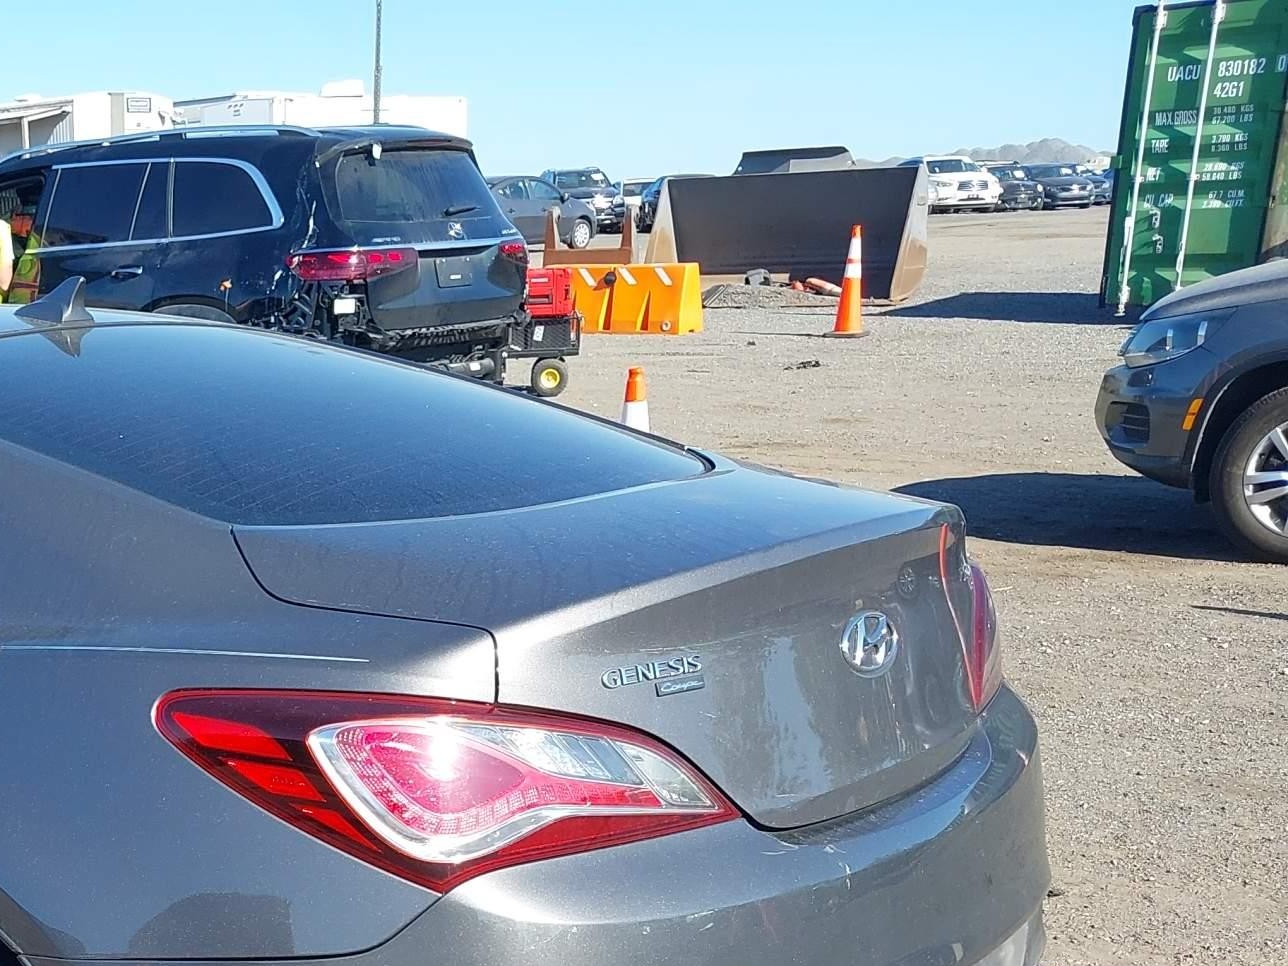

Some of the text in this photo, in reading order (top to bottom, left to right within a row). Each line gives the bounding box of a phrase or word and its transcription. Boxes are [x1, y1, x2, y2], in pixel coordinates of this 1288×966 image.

[1167, 65, 1201, 82] UACU
[1218, 58, 1266, 77] 830182
[1213, 81, 1245, 98] 42G1
[1240, 103, 1254, 112] KGS
[1239, 113, 1254, 122] LBS
[1234, 132, 1249, 142] KGS
[1151, 138, 1170, 153] TARE
[1234, 142, 1248, 151] LBS
[1146, 167, 1161, 182] NET
[1228, 171, 1242, 180] LBS
[601, 655, 703, 690] GENESIS
[660, 679, 705, 692] Coupe
